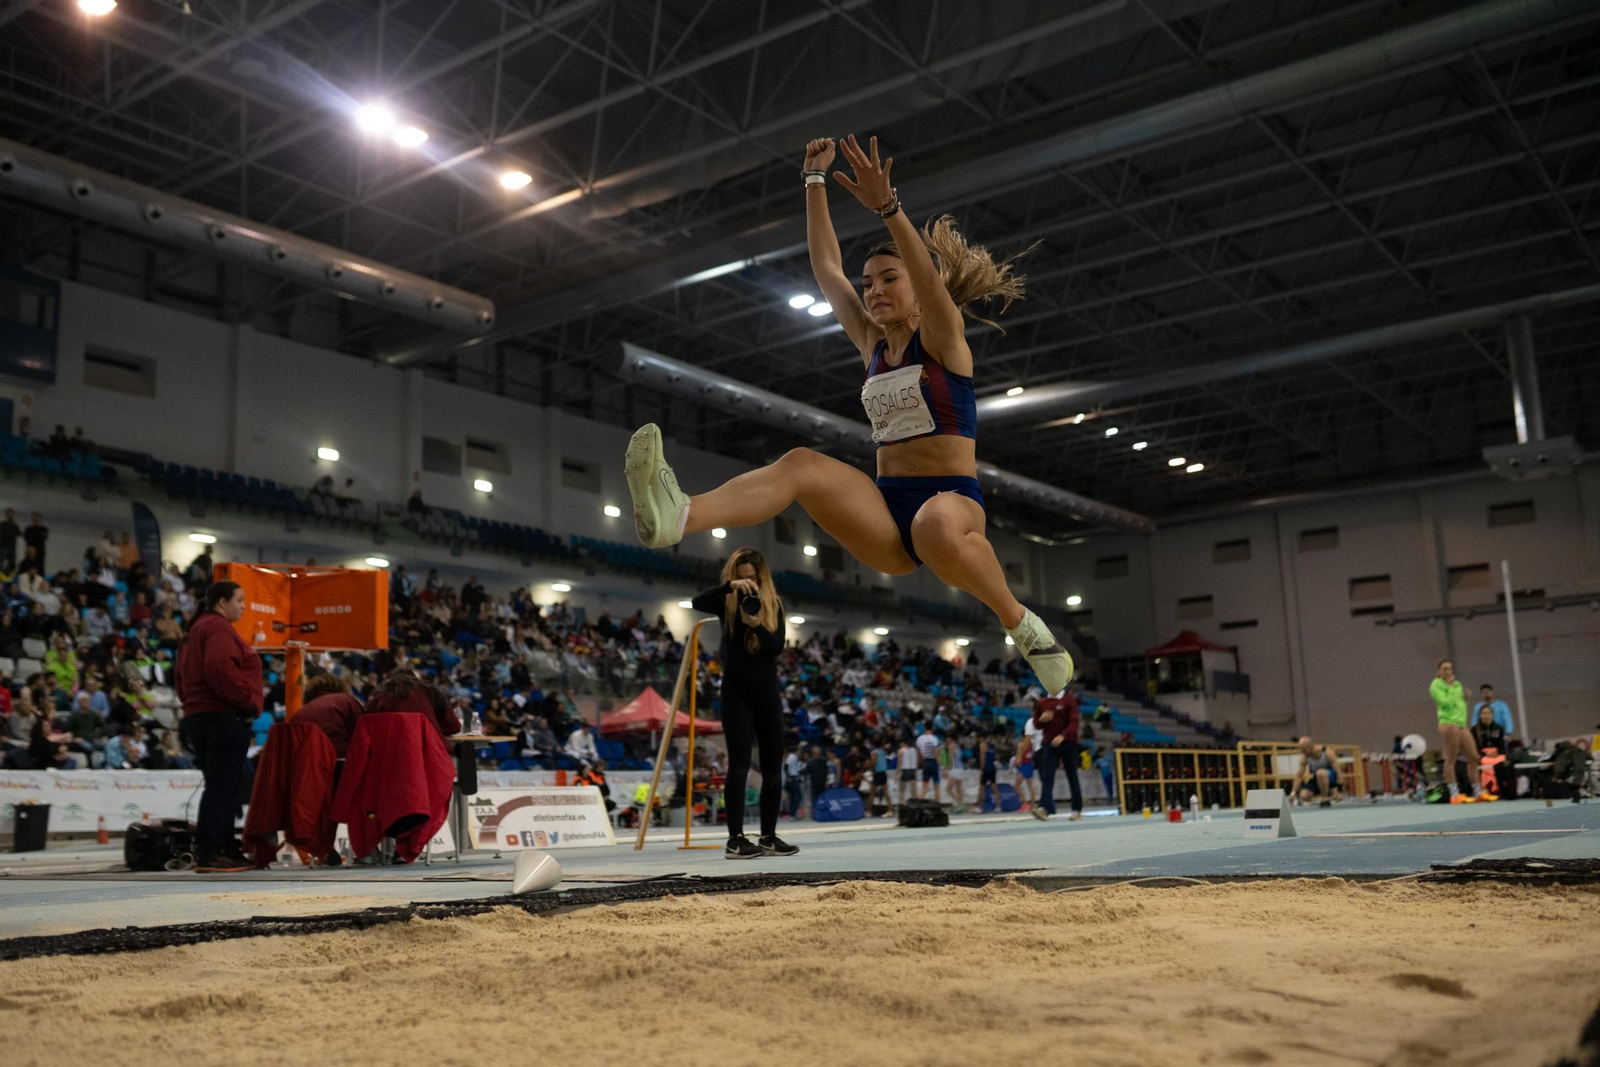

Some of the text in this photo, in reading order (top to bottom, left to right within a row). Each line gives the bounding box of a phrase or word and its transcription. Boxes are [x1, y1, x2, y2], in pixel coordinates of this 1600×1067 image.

[864, 386, 920, 419] ROSALES
[250, 602, 276, 615] MONDO
[315, 605, 352, 615] MONDO
[1023, 627, 1038, 651] NIKE
[532, 812, 587, 822] atletismofaa.es
